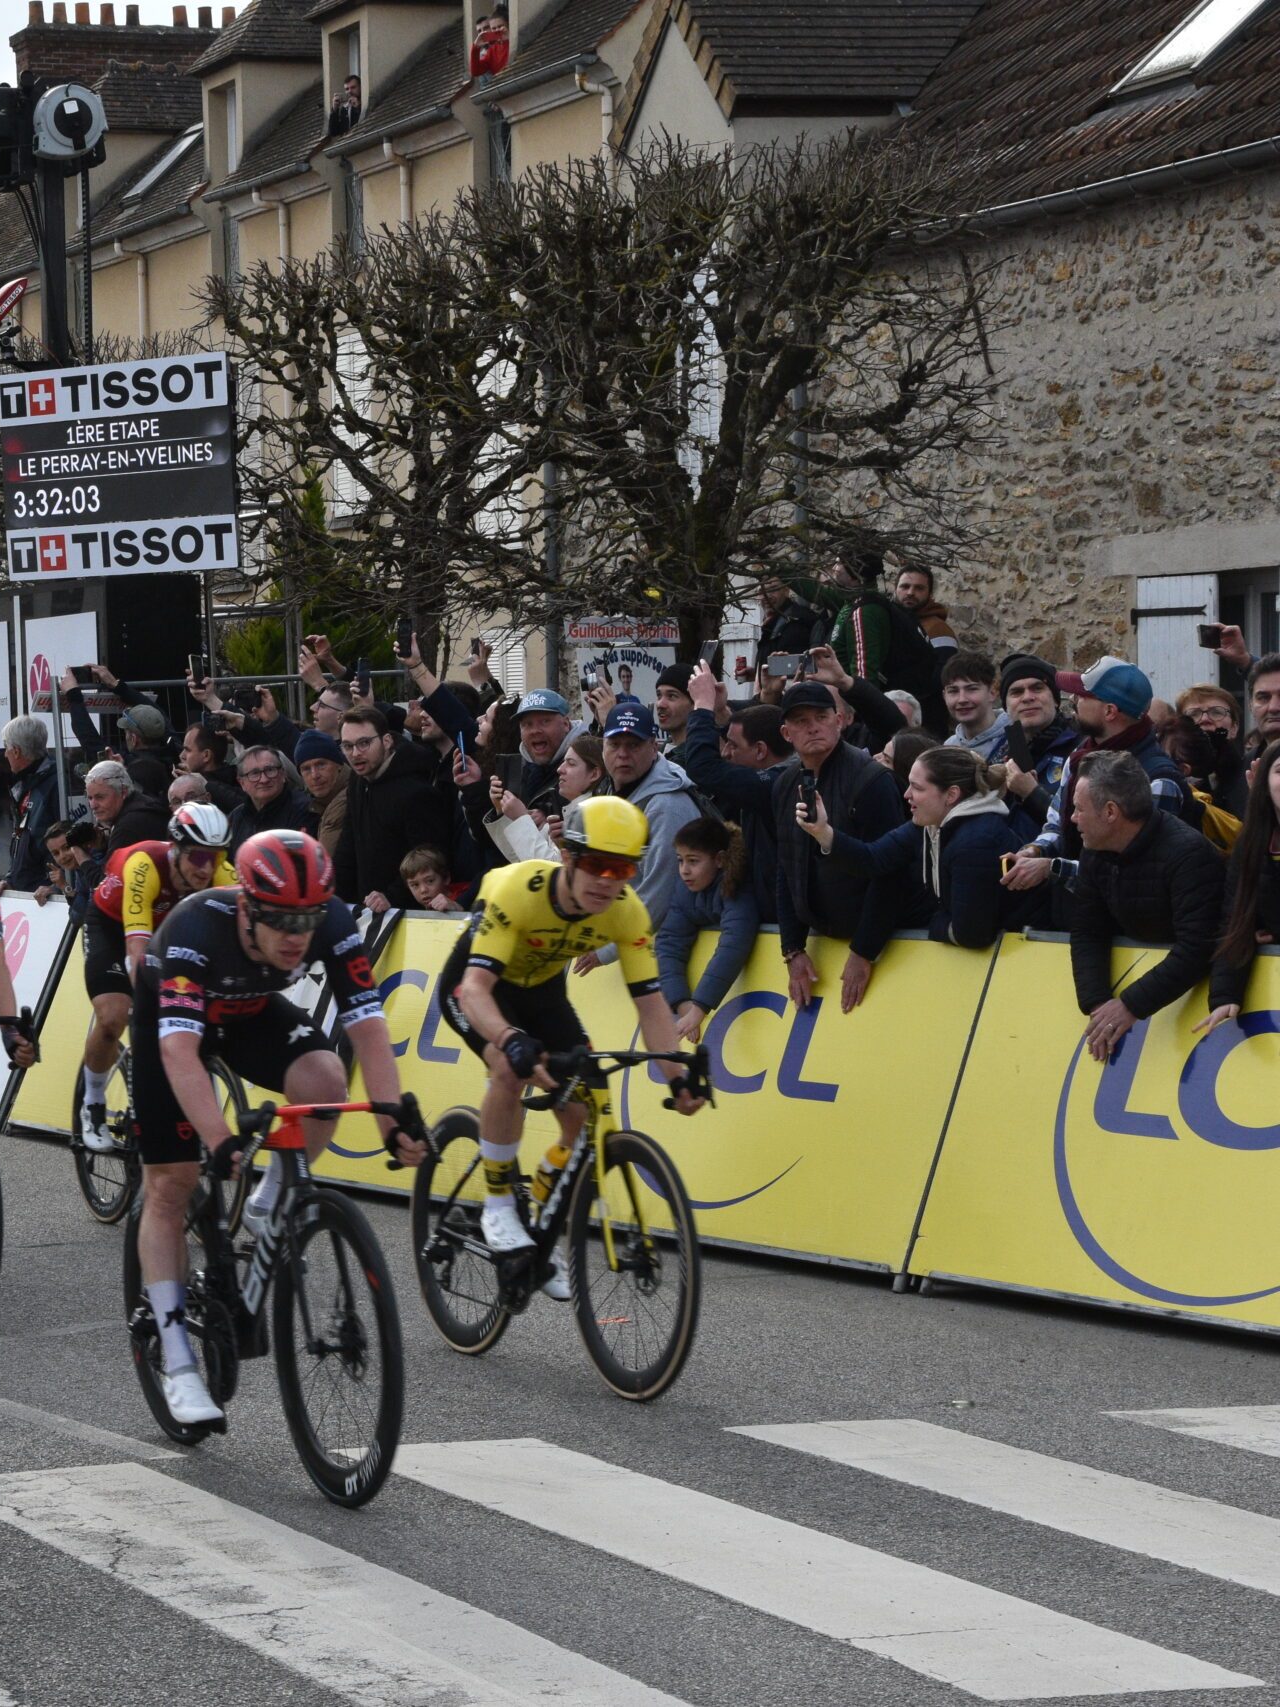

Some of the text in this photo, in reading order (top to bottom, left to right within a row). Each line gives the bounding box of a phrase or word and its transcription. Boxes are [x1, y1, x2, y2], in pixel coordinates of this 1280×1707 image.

[61, 361, 222, 412] TISSOT
[67, 419, 160, 445] 1ÈRE ETAPE
[19, 443, 213, 477] LE PERRAY-EN-YVELINES
[14, 485, 101, 518] 3:32:03
[72, 523, 232, 569] TISSOT
[128, 861, 150, 915] Cofidis
[375, 969, 462, 1064] CL
[647, 989, 840, 1104] CL
